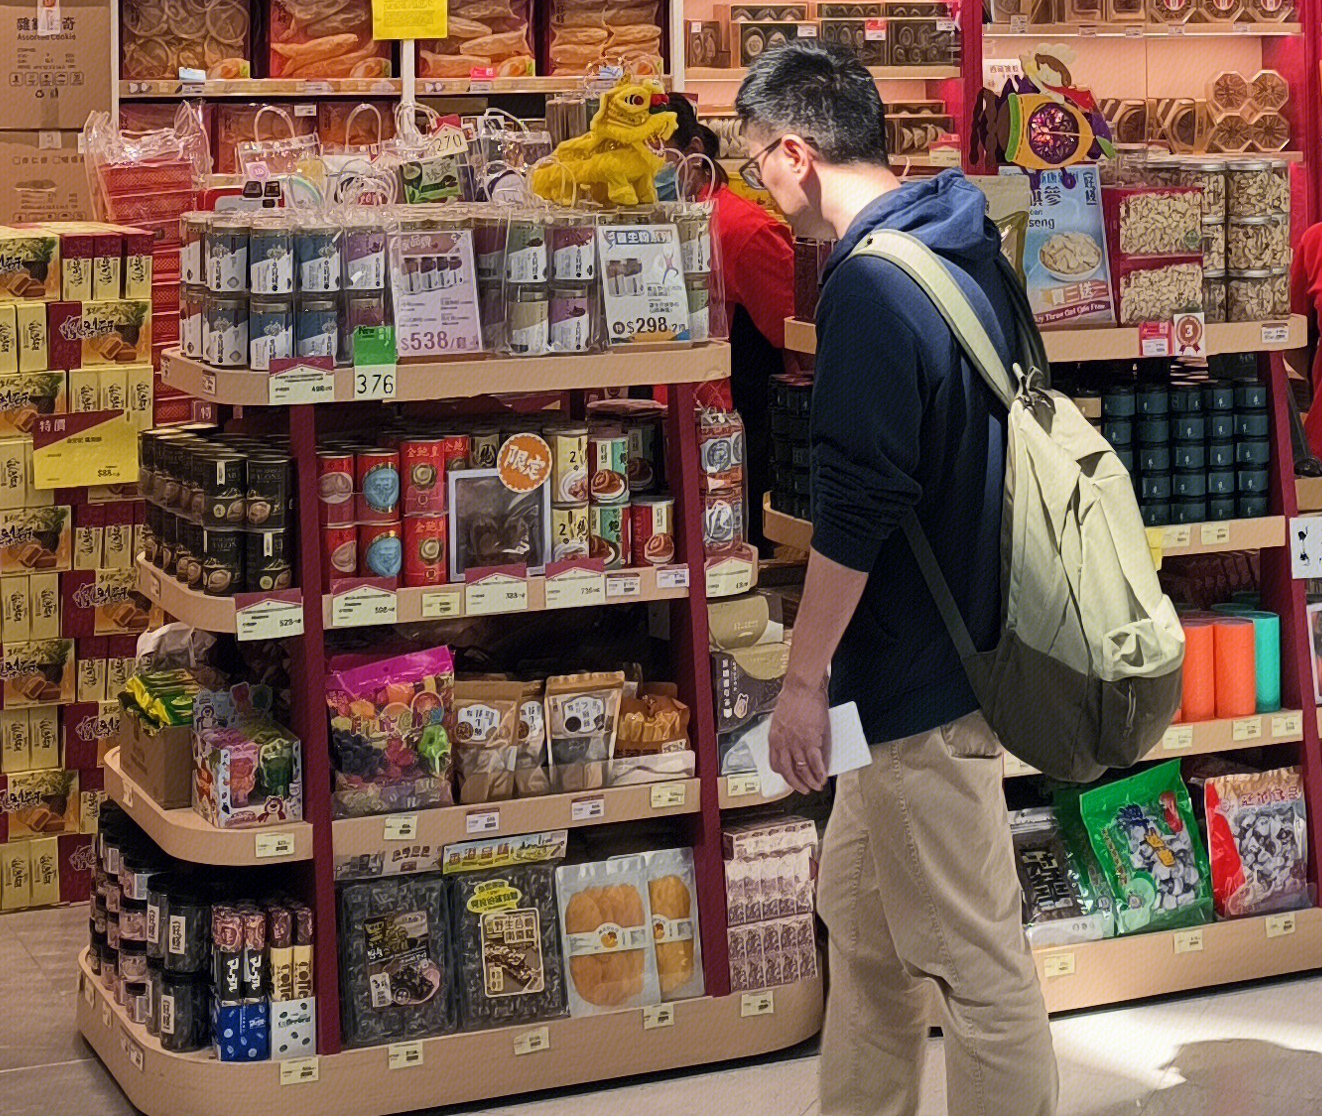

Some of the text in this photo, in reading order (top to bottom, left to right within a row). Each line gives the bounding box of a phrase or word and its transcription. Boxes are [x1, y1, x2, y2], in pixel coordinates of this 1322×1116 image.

[437, 134, 462, 152] 270
[357, 374, 394, 395] 376
[504, 444, 546, 481] 限定
